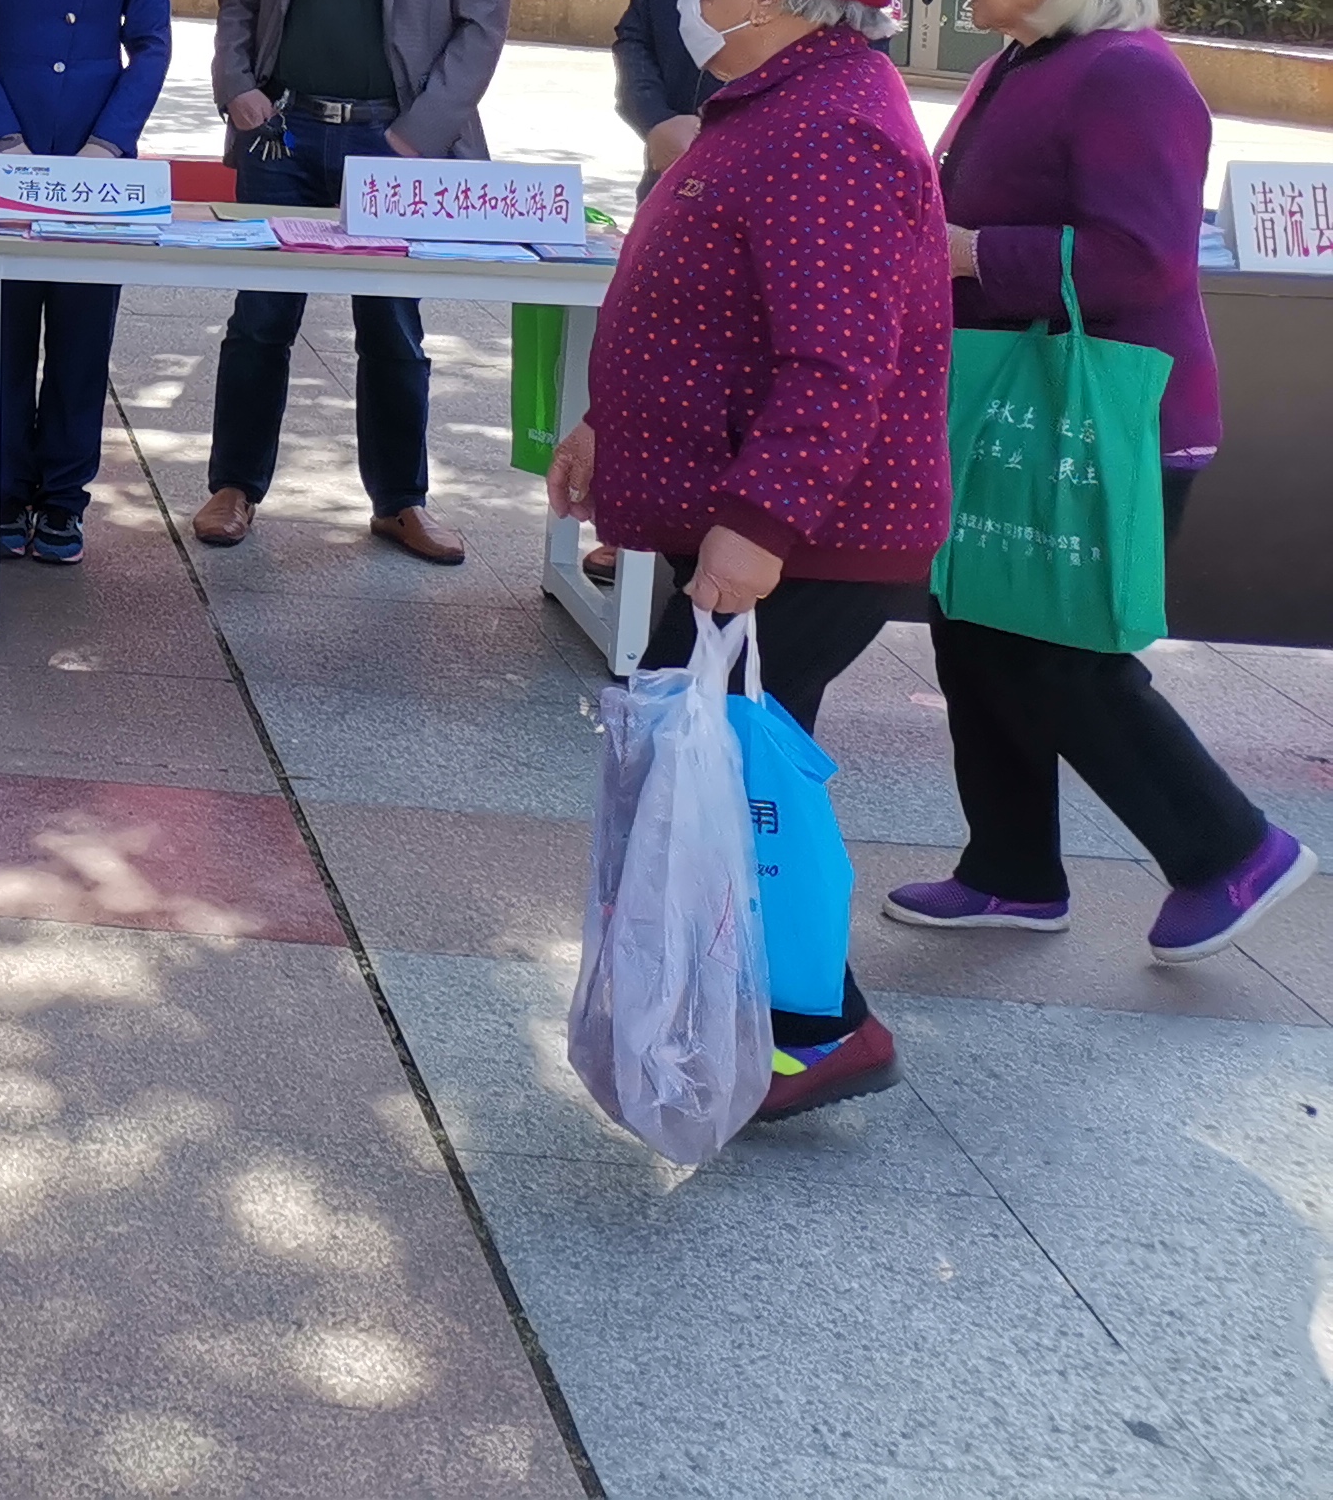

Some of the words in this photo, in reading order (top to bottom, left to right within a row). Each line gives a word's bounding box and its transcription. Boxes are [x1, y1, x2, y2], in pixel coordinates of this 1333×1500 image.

[18, 180, 147, 205] 清流分公司
[361, 173, 570, 225] 清流县文体和旅游局
